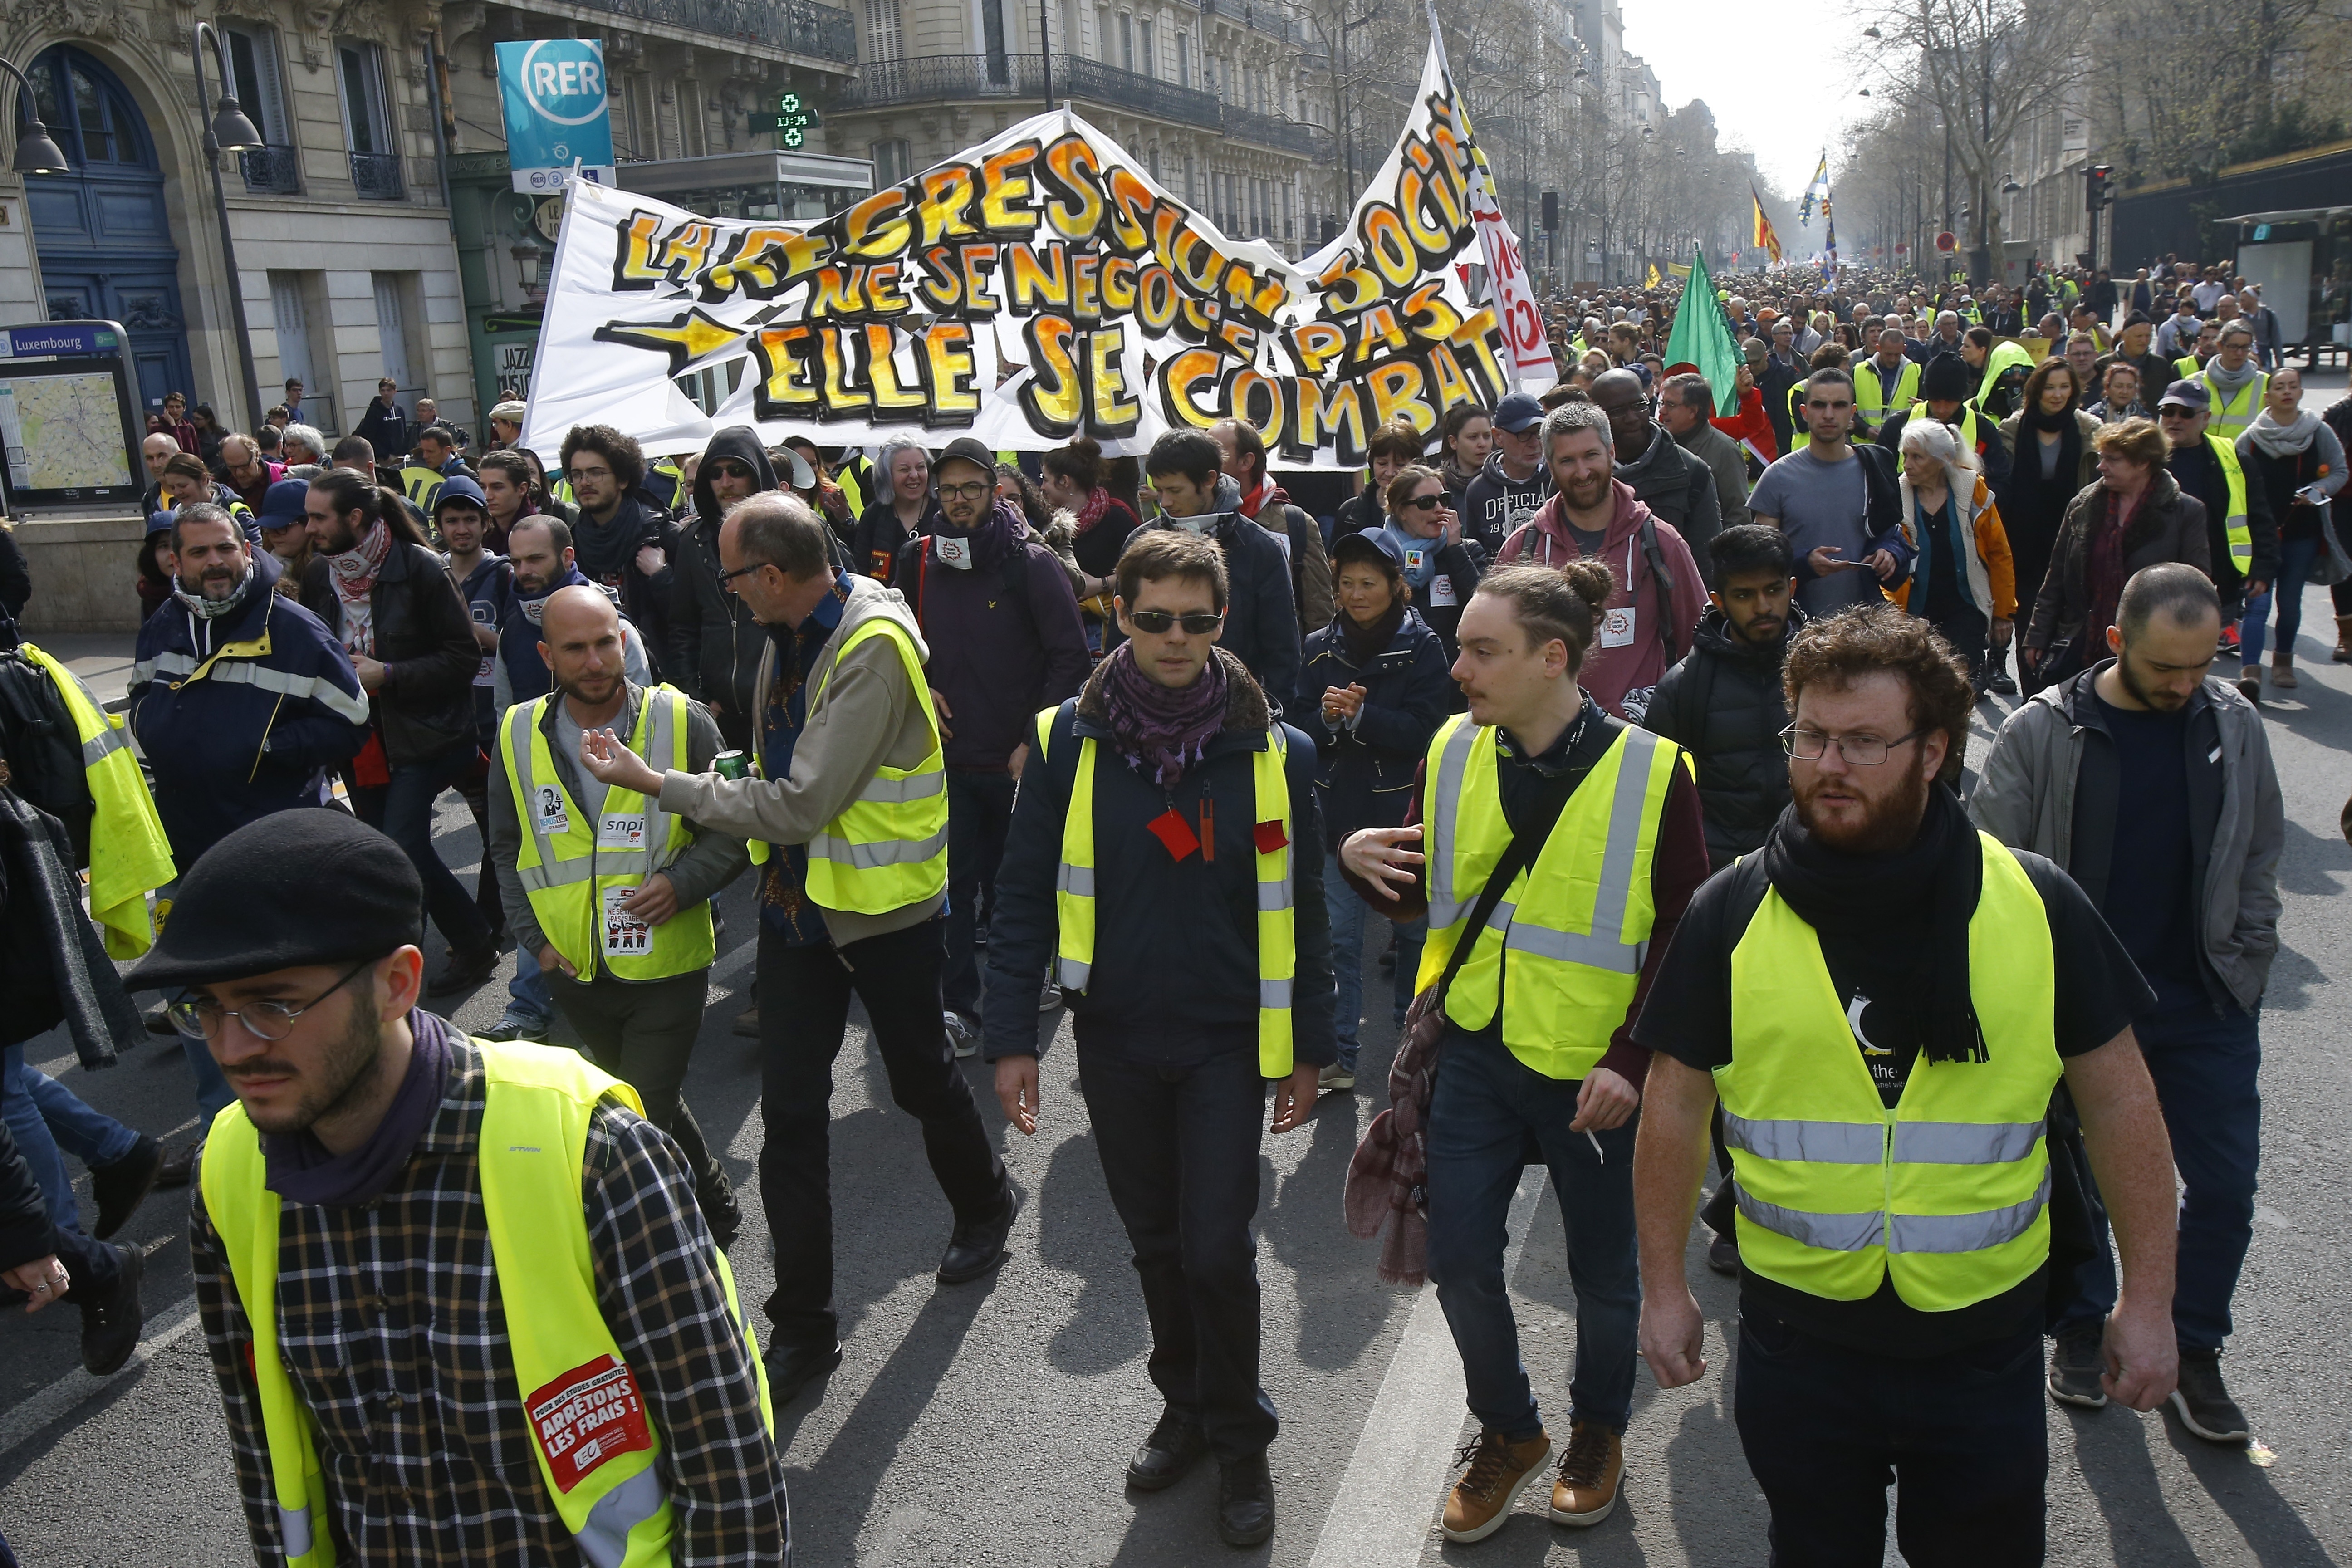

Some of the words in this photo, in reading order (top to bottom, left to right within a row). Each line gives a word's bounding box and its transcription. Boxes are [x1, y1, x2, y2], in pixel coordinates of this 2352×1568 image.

[534, 62, 601, 96] RER
[451, 158, 490, 172] JAZZ
[553, 175, 559, 183] B
[548, 205, 559, 220] LE
[612, 208, 720, 291] LA
[807, 259, 911, 323] NE
[912, 243, 1001, 318] SE
[1279, 279, 1464, 373] PAS
[15, 337, 82, 350] Luxembourg
[502, 348, 530, 370] JAZZ
[747, 318, 981, 430] ELLE
[1017, 312, 1141, 439] SE
[1158, 299, 1507, 466] COMBAT
[606, 818, 645, 834] snpi
[1872, 1064, 1895, 1078] the
[535, 1402, 553, 1418] POUR
[554, 1394, 565, 1407] DES
[591, 1368, 626, 1386] GRATUITES
[541, 1379, 632, 1440] ARRÊTONS
[546, 1427, 576, 1459] LES
[576, 1400, 626, 1437] FRAIS
[629, 1396, 638, 1412] !
